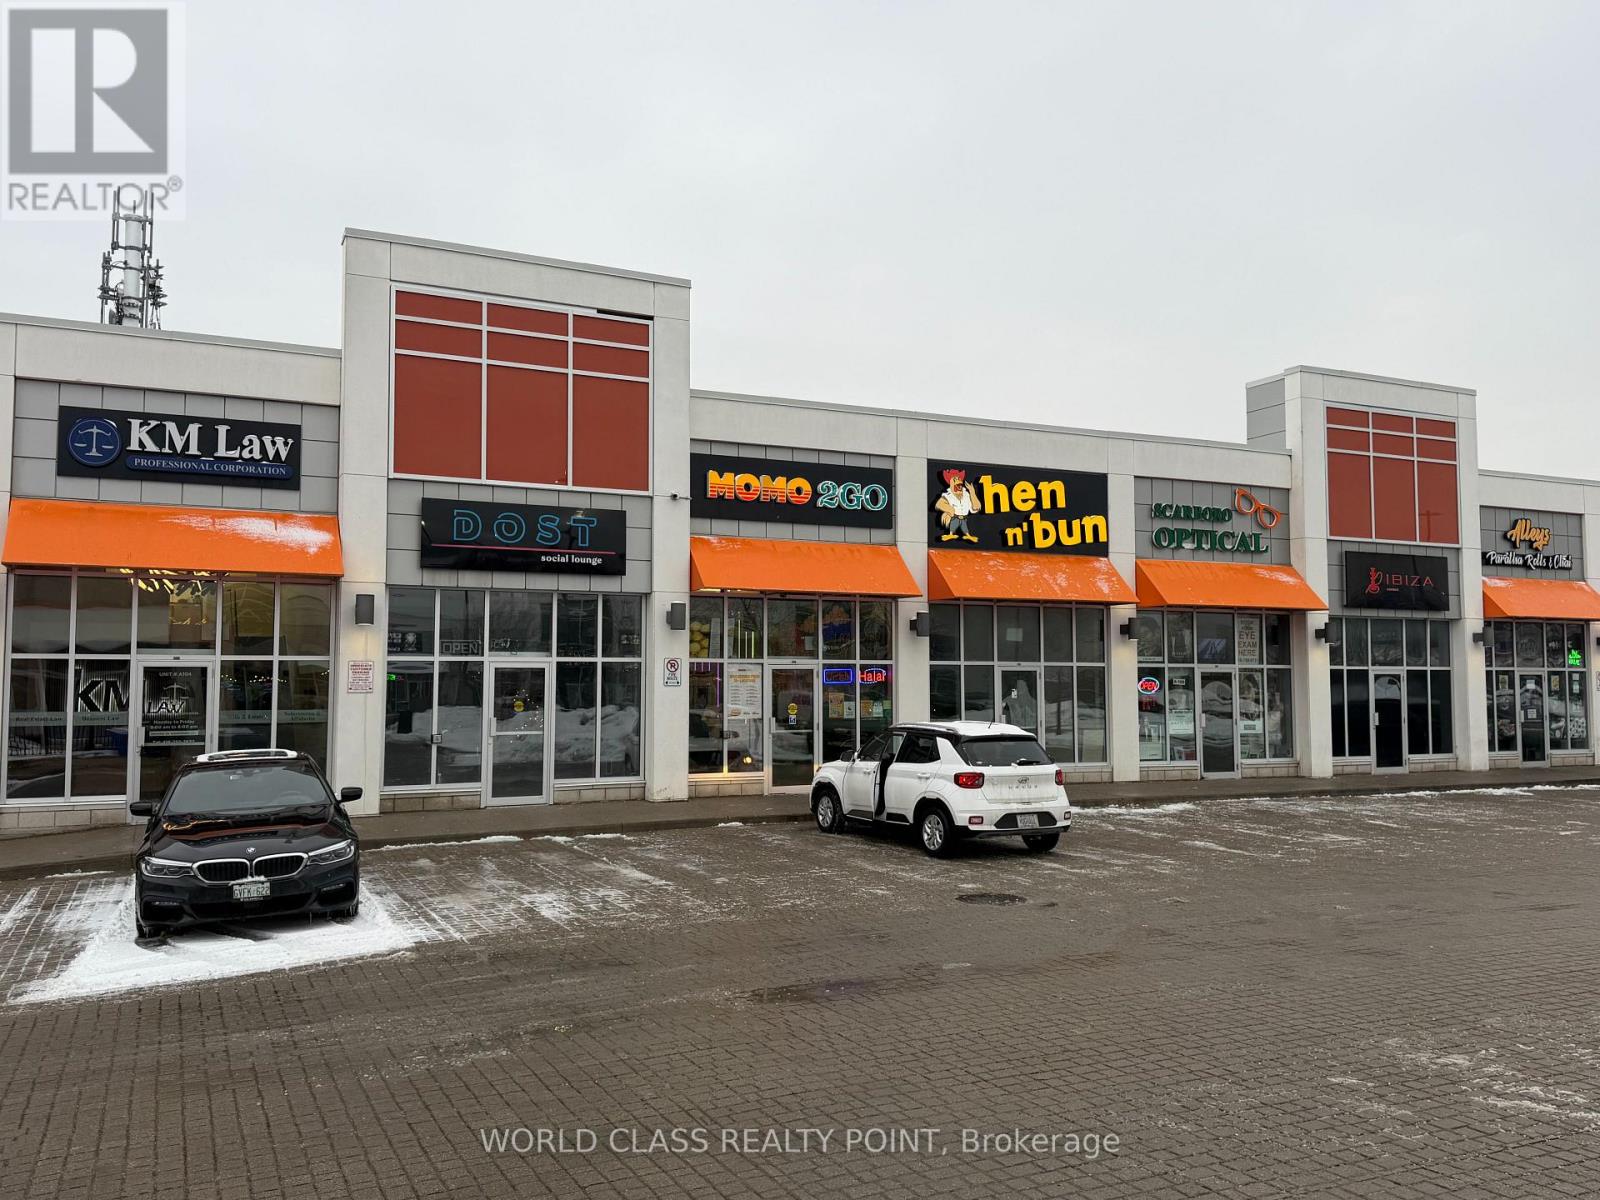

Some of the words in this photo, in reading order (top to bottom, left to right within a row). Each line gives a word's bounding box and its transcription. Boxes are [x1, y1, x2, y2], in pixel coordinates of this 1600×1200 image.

[126, 418, 203, 456] KM
[214, 424, 295, 462] Law
[134, 457, 212, 471] PROFESSIONAL
[213, 462, 287, 476] CORPORATION
[707, 469, 812, 505] MOMO
[816, 480, 888, 511] 2GO
[977, 472, 1067, 515] hen
[453, 509, 598, 547] DOST
[1506, 518, 1552, 551] Alleys
[1152, 526, 1269, 553] OPTICAL
[540, 554, 569, 564] social
[571, 555, 603, 565] lounge
[1525, 552, 1547, 570] Rolls
[1554, 554, 1572, 569] Chai
[1386, 573, 1434, 587] IBIZA
[1238, 640, 1257, 649] EXAM
[1239, 631, 1256, 640] EYE
[442, 642, 478, 654] OPEN
[1238, 649, 1257, 657] HERE
[1140, 682, 1158, 691] OPEN
